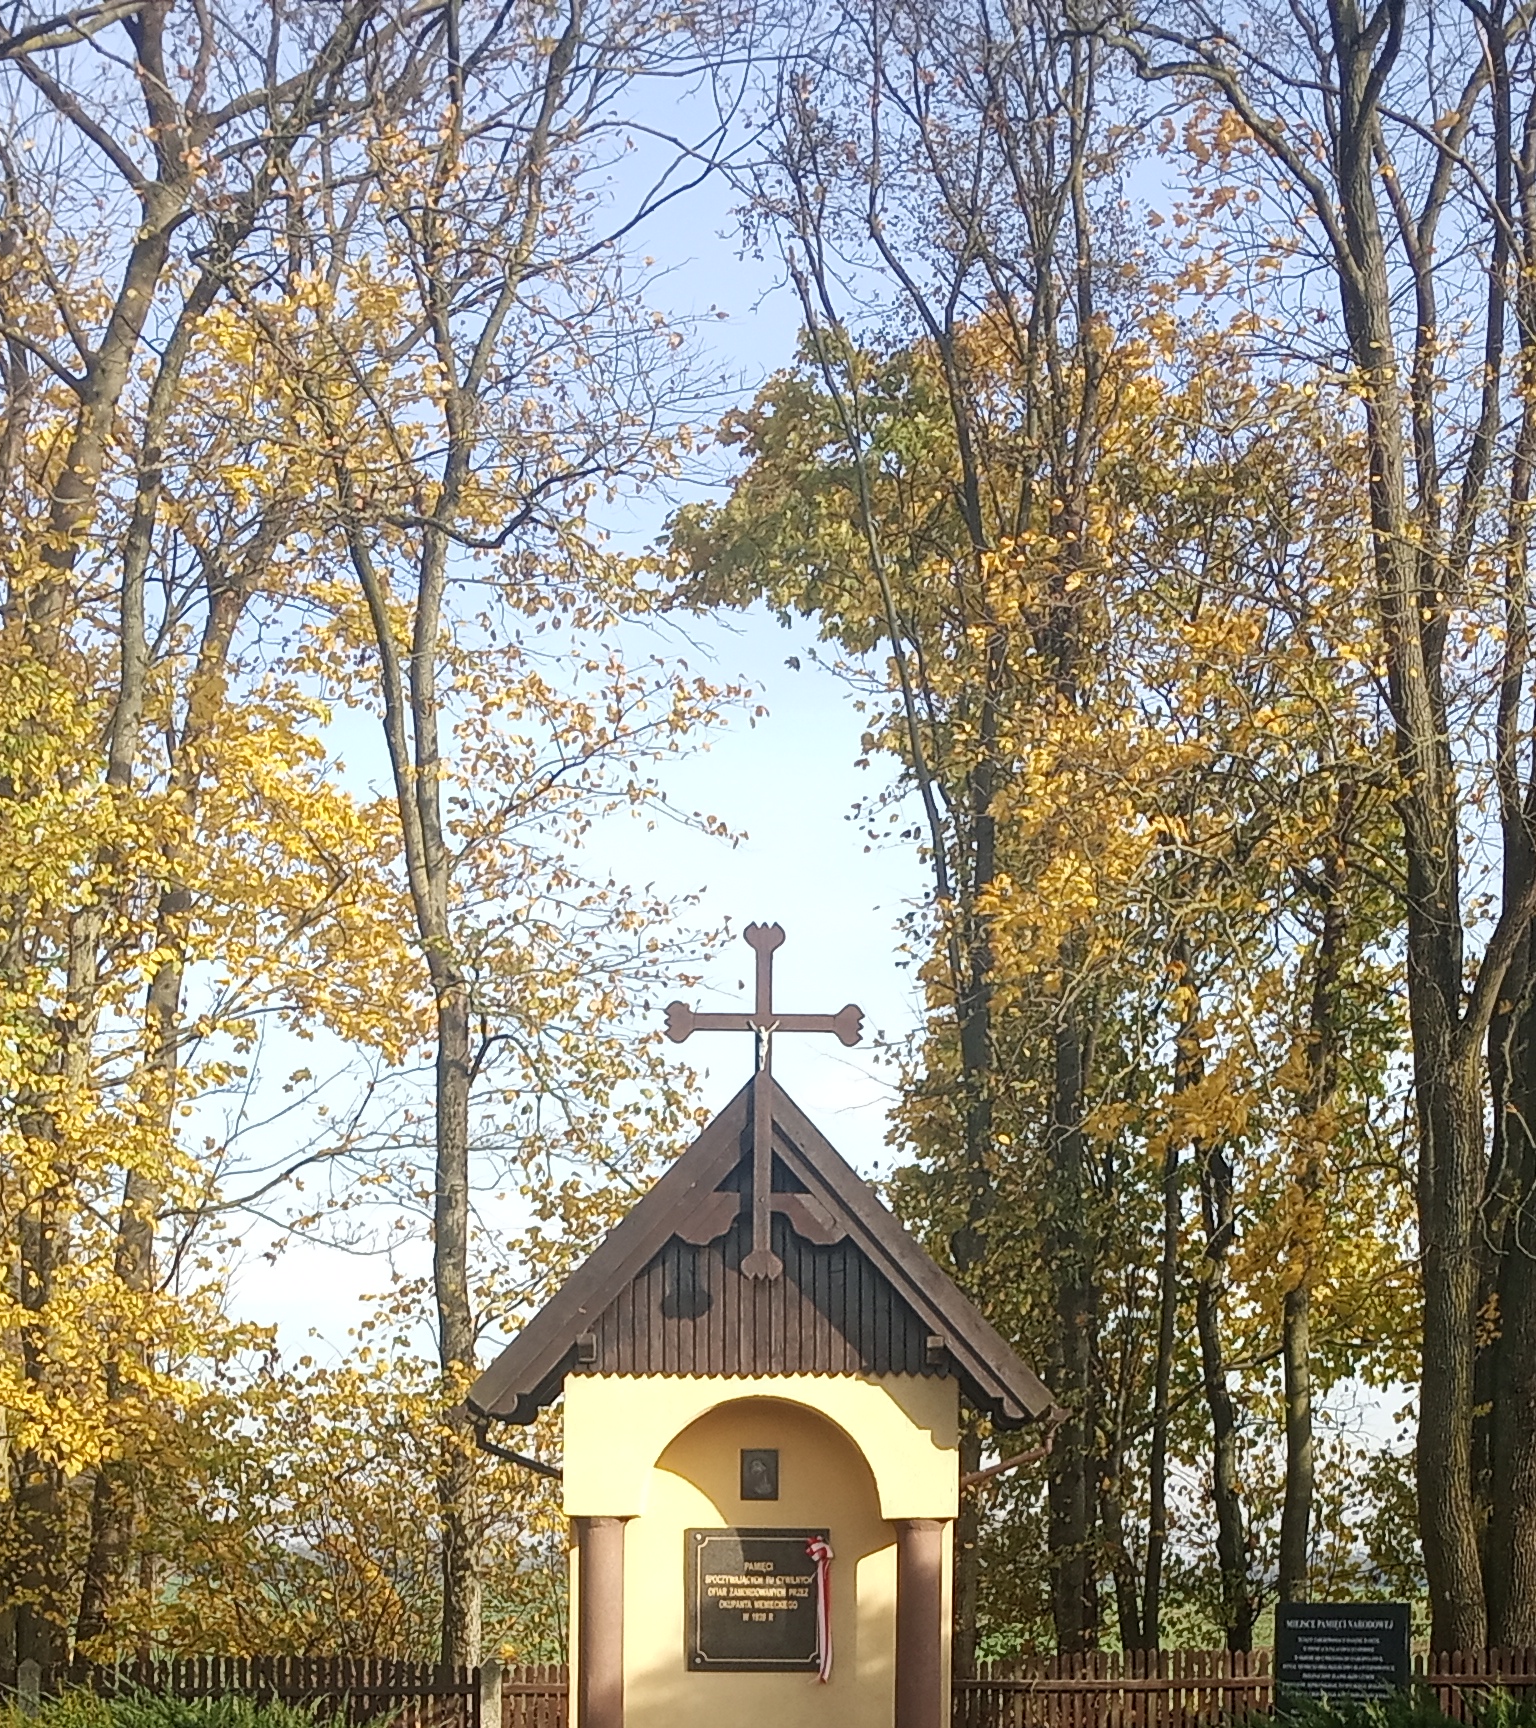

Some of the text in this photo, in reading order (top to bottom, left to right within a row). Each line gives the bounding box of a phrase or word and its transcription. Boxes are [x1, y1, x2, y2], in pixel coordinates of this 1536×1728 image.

[744, 1562, 773, 1573] PAMIĘCI
[1286, 1619, 1394, 1630] MIEJSCE PAMIĘCI NARODOWEJ
